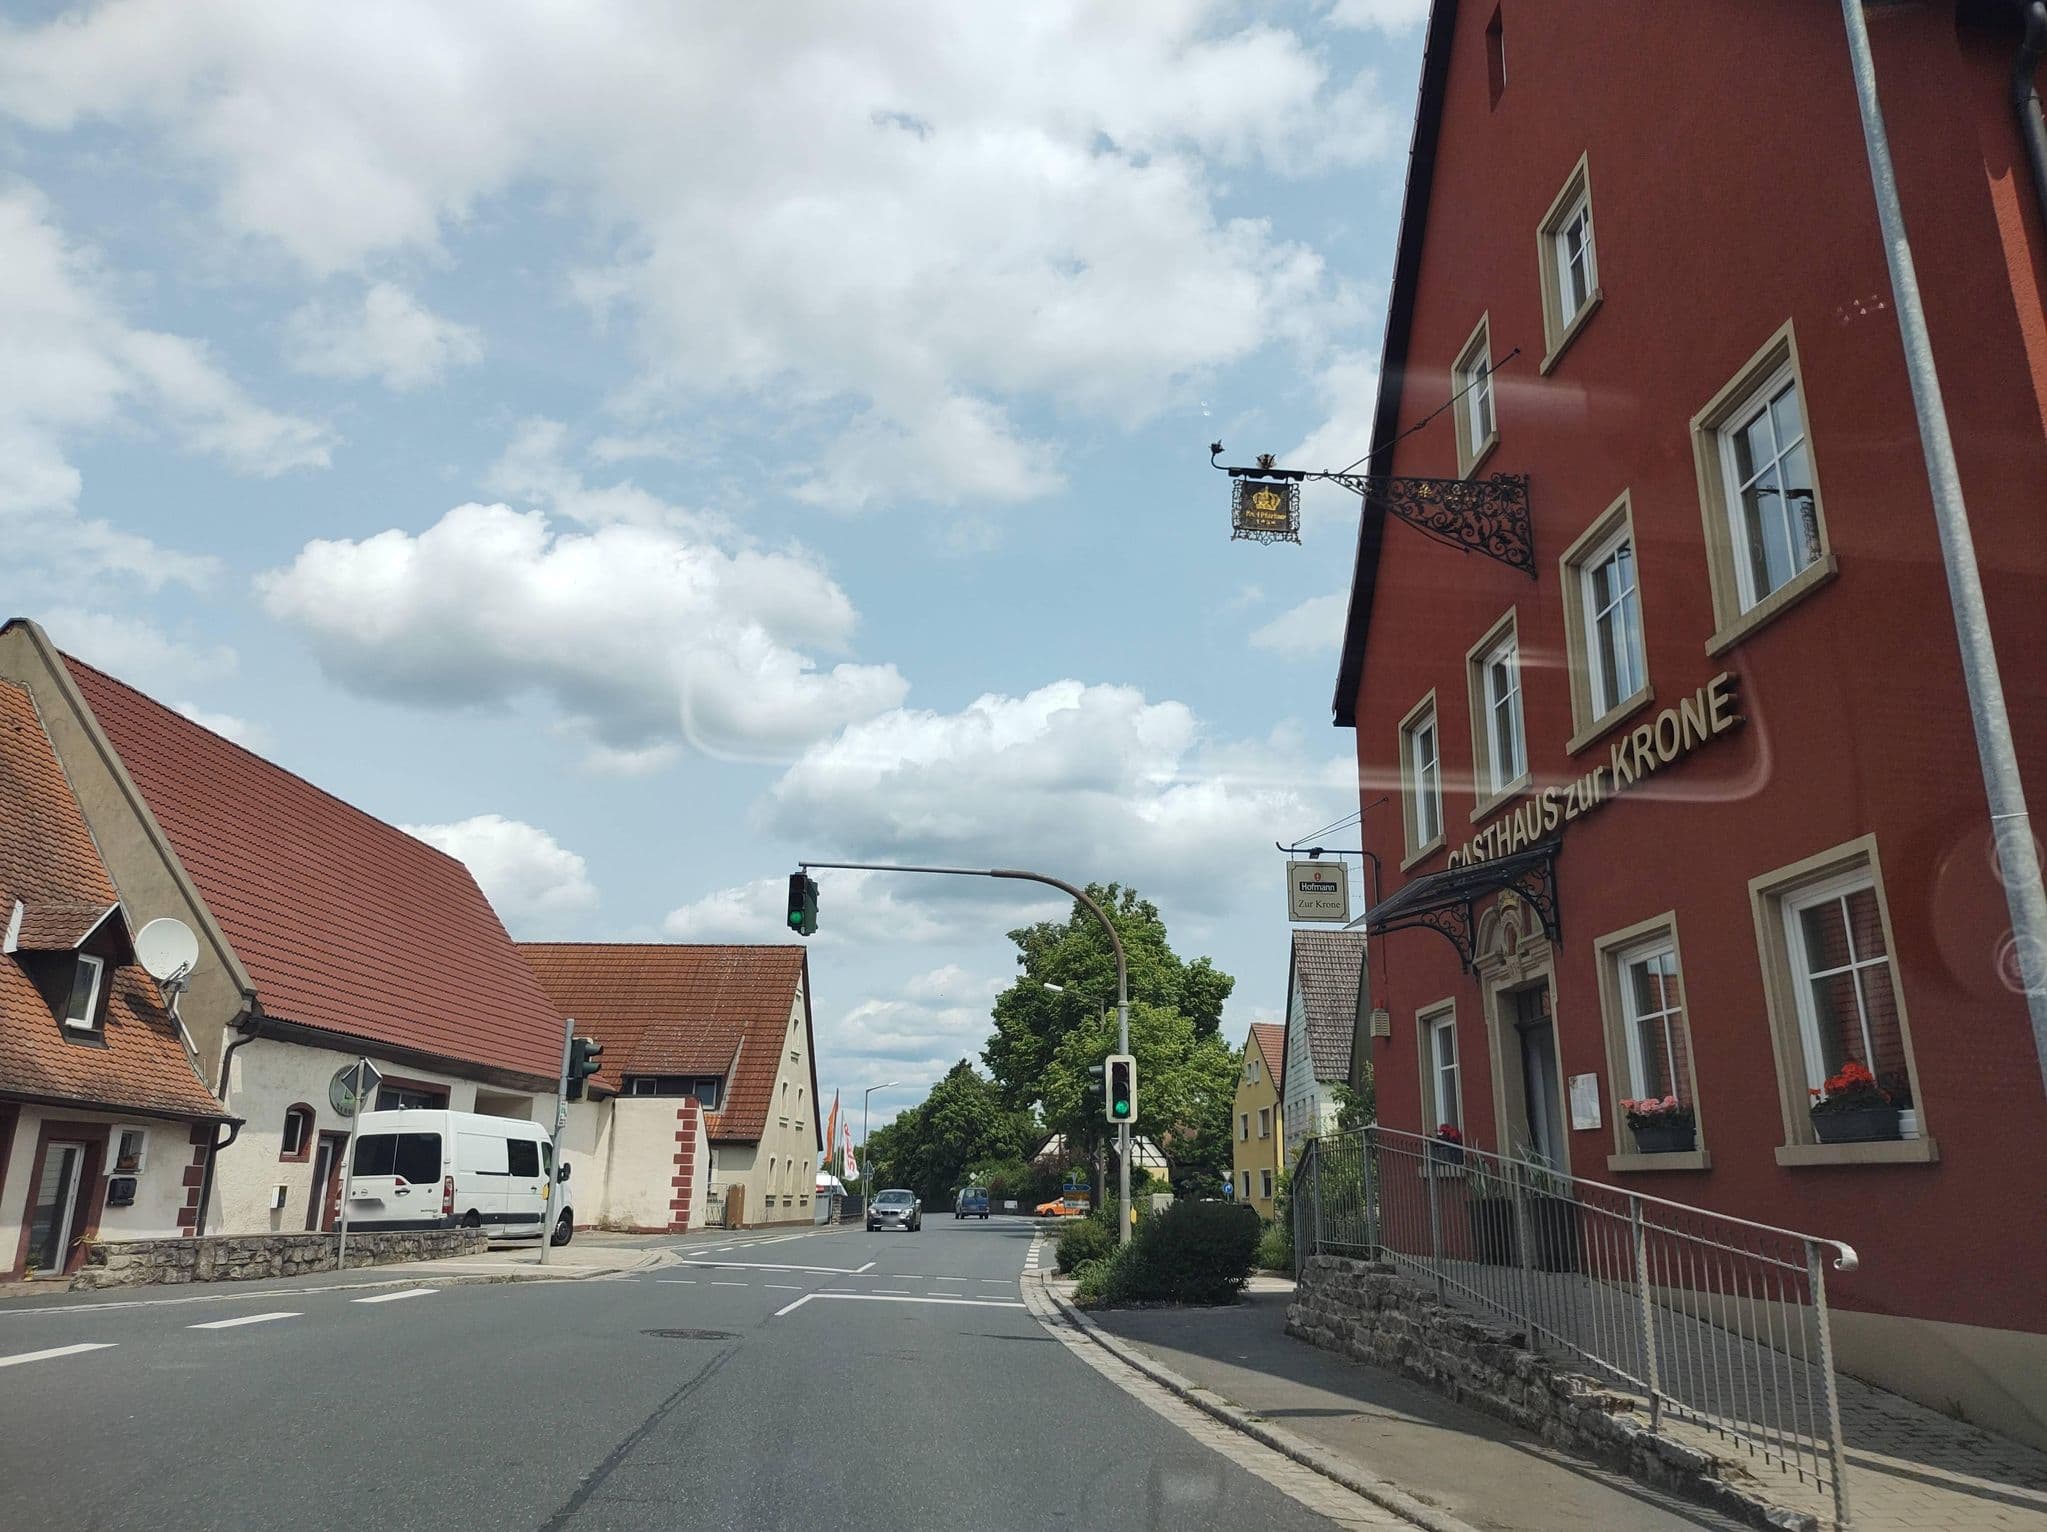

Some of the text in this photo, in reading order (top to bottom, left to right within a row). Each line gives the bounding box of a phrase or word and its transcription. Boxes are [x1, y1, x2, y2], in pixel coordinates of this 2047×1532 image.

[1563, 765, 1603, 820] zur
[1611, 671, 1735, 791] KRONE
[1301, 882, 1335, 892] Hofmann
[1298, 900, 1341, 909] Zur Krone
